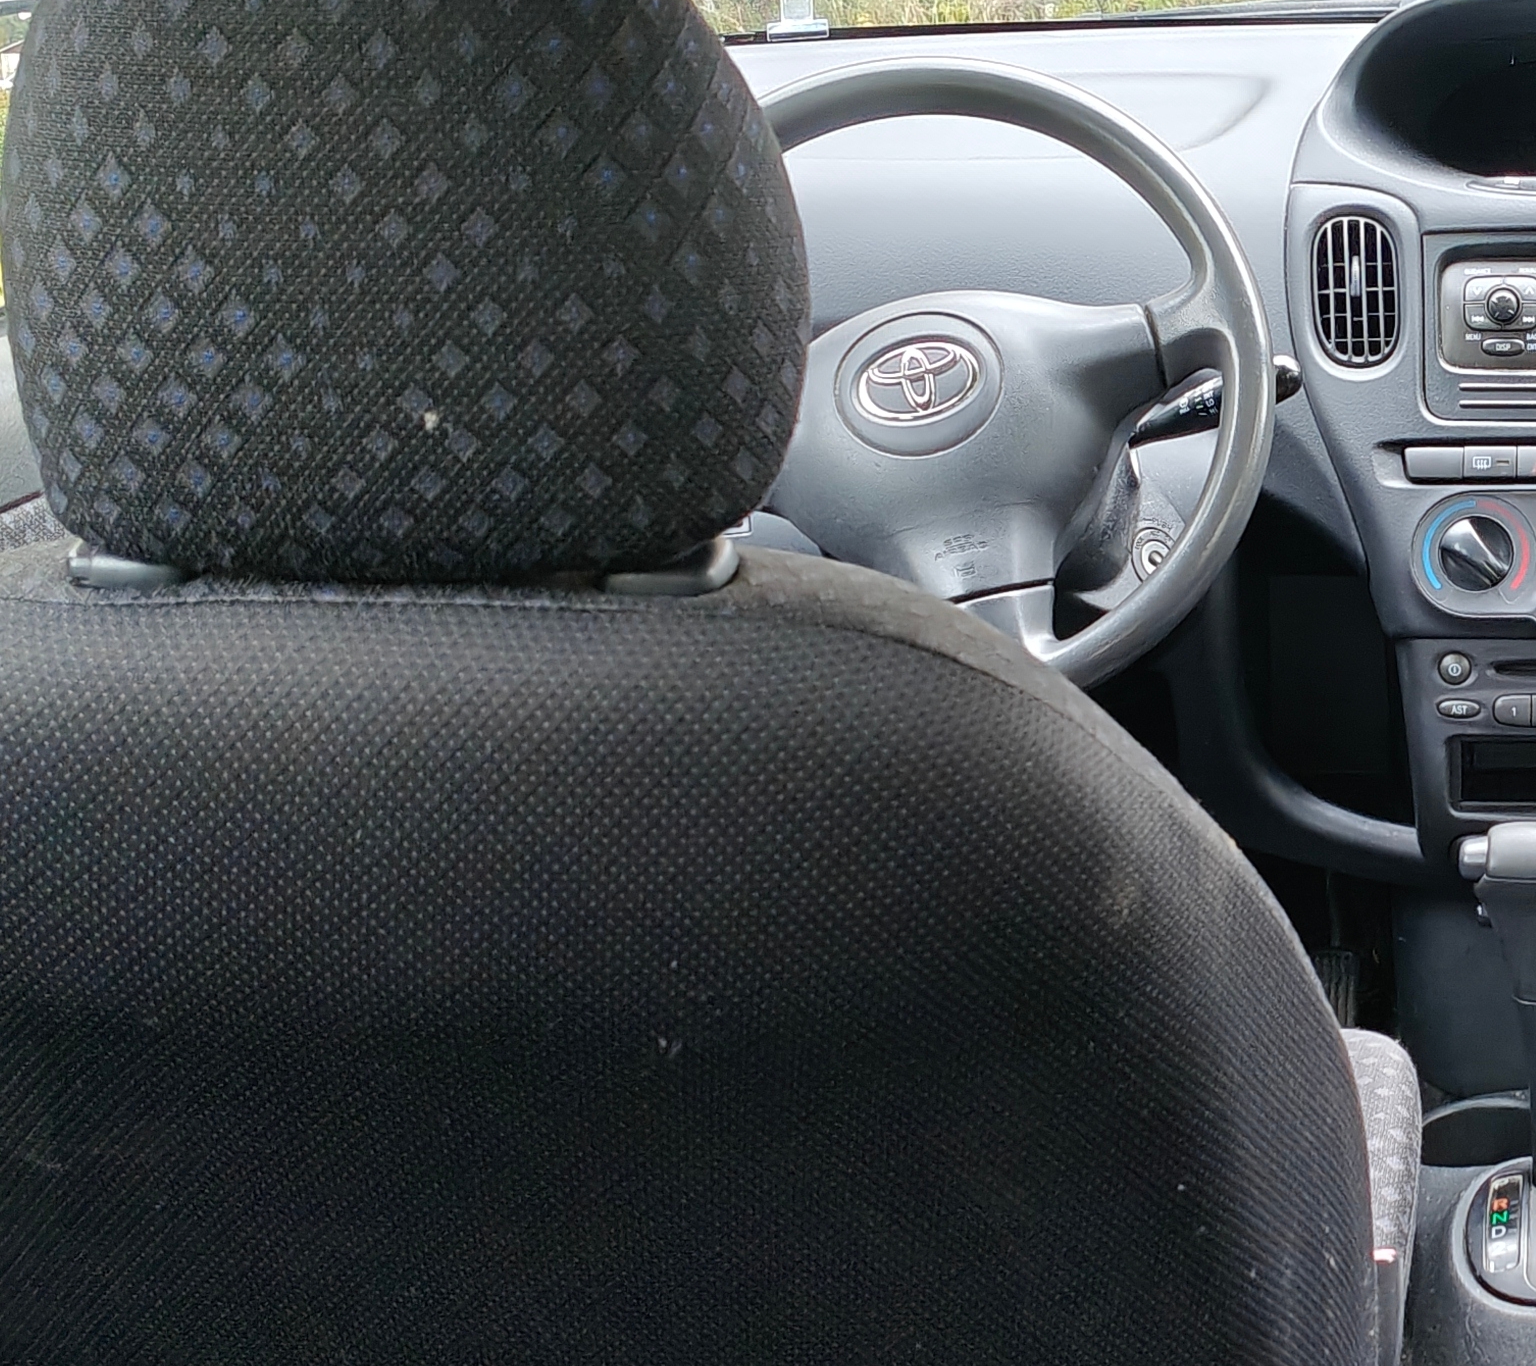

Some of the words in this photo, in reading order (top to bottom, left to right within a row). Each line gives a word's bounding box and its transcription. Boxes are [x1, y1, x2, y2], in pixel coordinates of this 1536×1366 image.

[1451, 705, 1468, 716] AST
[1511, 707, 1517, 717] 1
[1492, 1197, 1509, 1211] R
[1491, 1210, 1509, 1225] N
[1491, 1225, 1507, 1239] D
